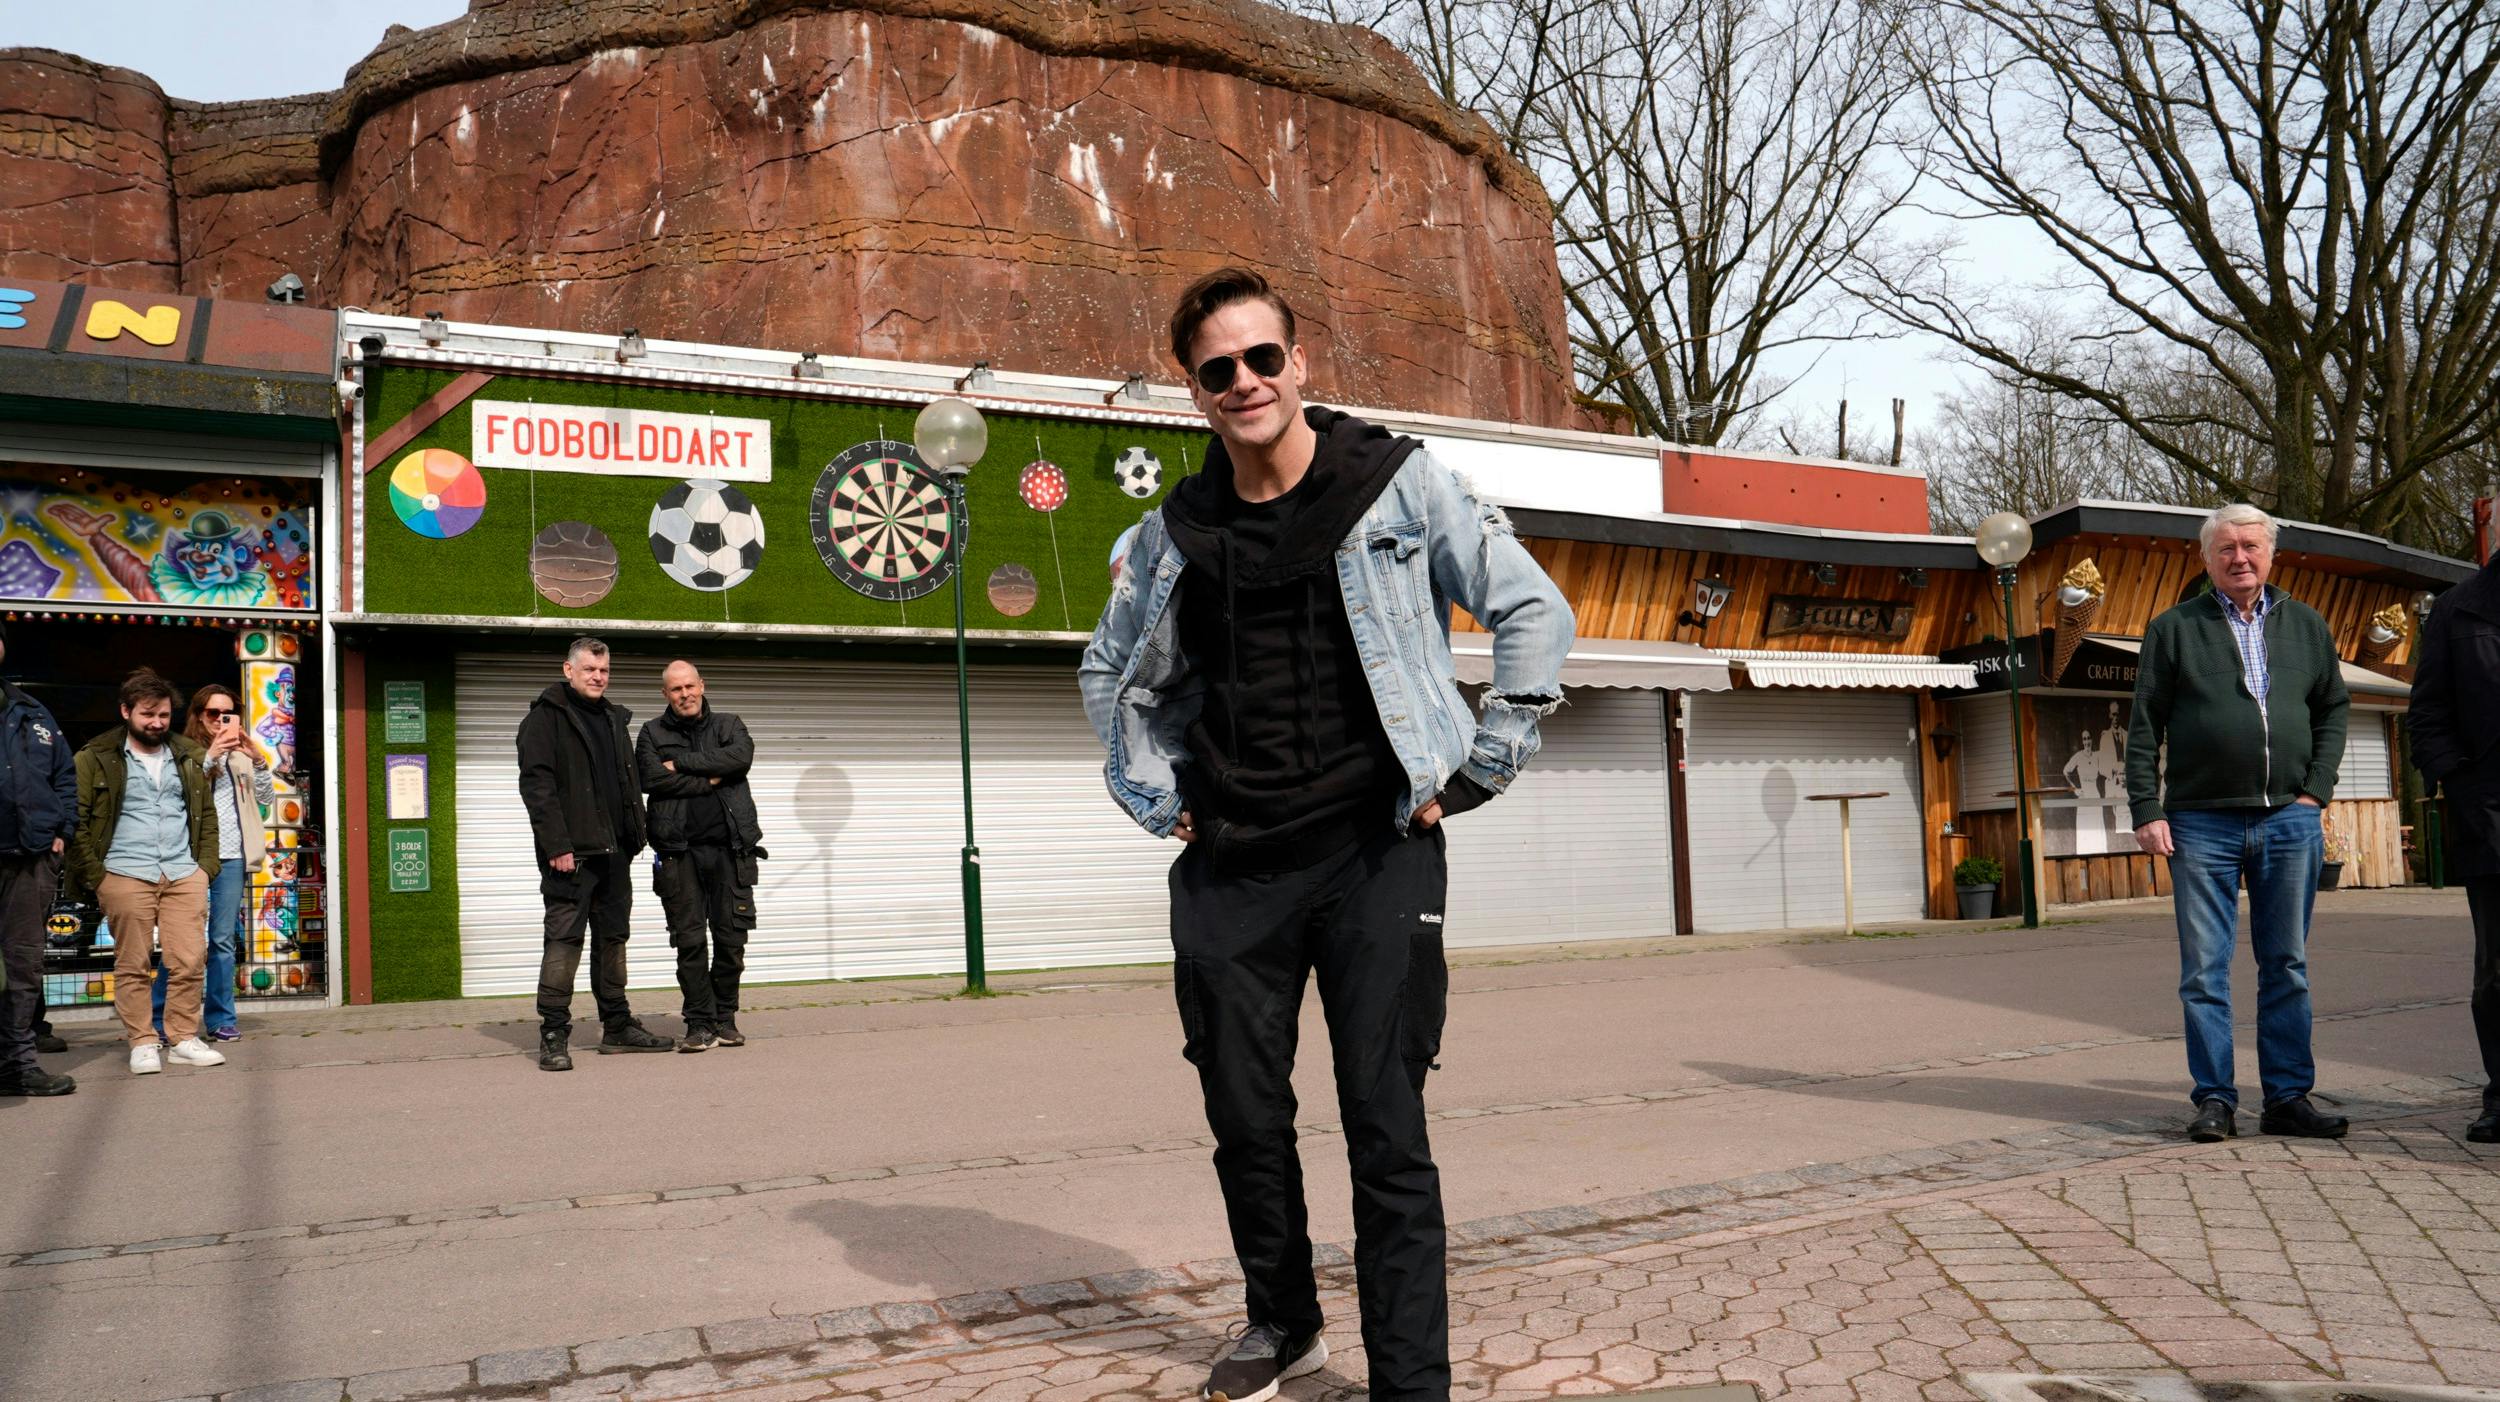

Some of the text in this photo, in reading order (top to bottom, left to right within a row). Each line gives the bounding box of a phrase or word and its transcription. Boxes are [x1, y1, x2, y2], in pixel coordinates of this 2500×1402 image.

[487, 414, 753, 468] FODBOLDDART
[865, 441, 872, 451] 5
[881, 440, 896, 451] 20
[840, 450, 853, 463] 12
[826, 463, 837, 475] 9
[810, 512, 821, 522] 11
[813, 536, 827, 544] 8
[822, 553, 837, 567] 16
[929, 577, 938, 588] 2
[858, 583, 874, 595] 19
[907, 587, 918, 599] 17
[888, 590, 895, 600] 3
[2088, 664, 2120, 680] CRAFT
[395, 842, 401, 850] 3
